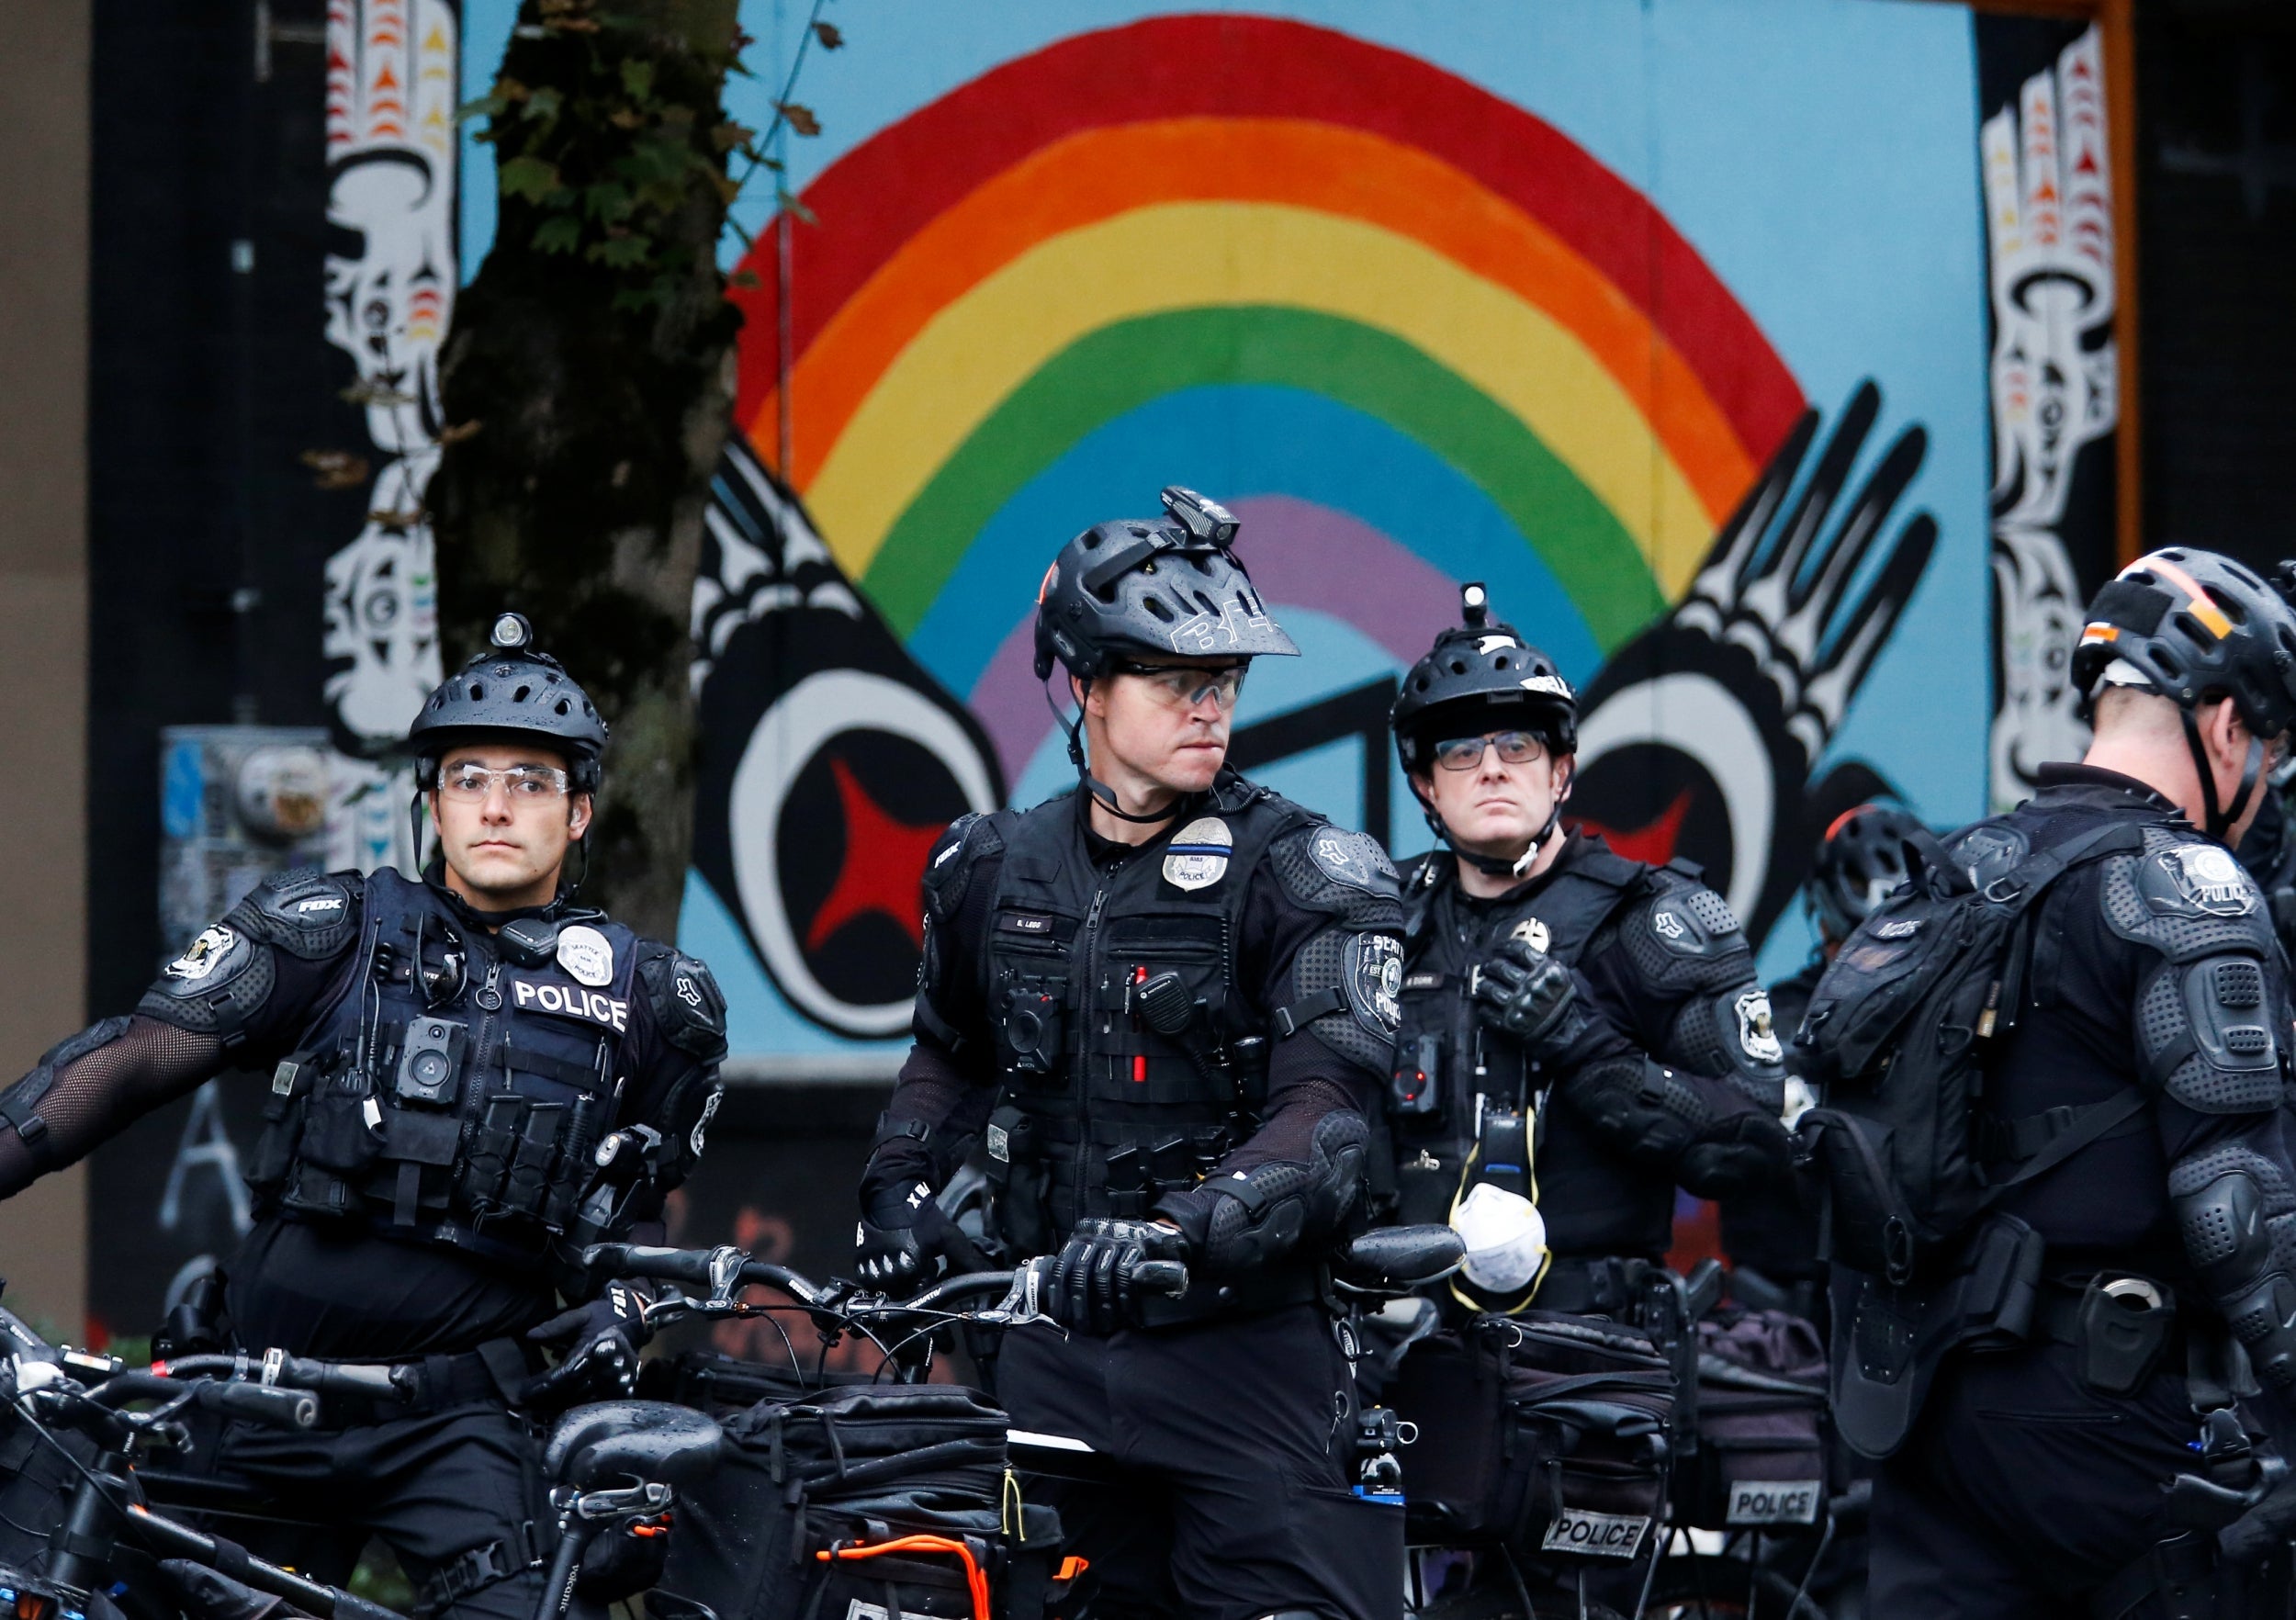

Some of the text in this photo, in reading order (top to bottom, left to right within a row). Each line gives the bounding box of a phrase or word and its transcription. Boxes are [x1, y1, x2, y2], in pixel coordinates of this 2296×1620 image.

[934, 840, 961, 869] FOX
[1179, 871, 1205, 881] POLICE
[298, 899, 343, 913] FOX
[571, 944, 599, 955] SEATTLE
[574, 964, 596, 978] POLICE
[514, 980, 627, 1033] POLICE
[610, 1287, 627, 1319] FOX
[1737, 1491, 1810, 1514] POLICE
[1552, 1518, 1641, 1547] POLICE
[558, 1562, 580, 1614] Volcanic
